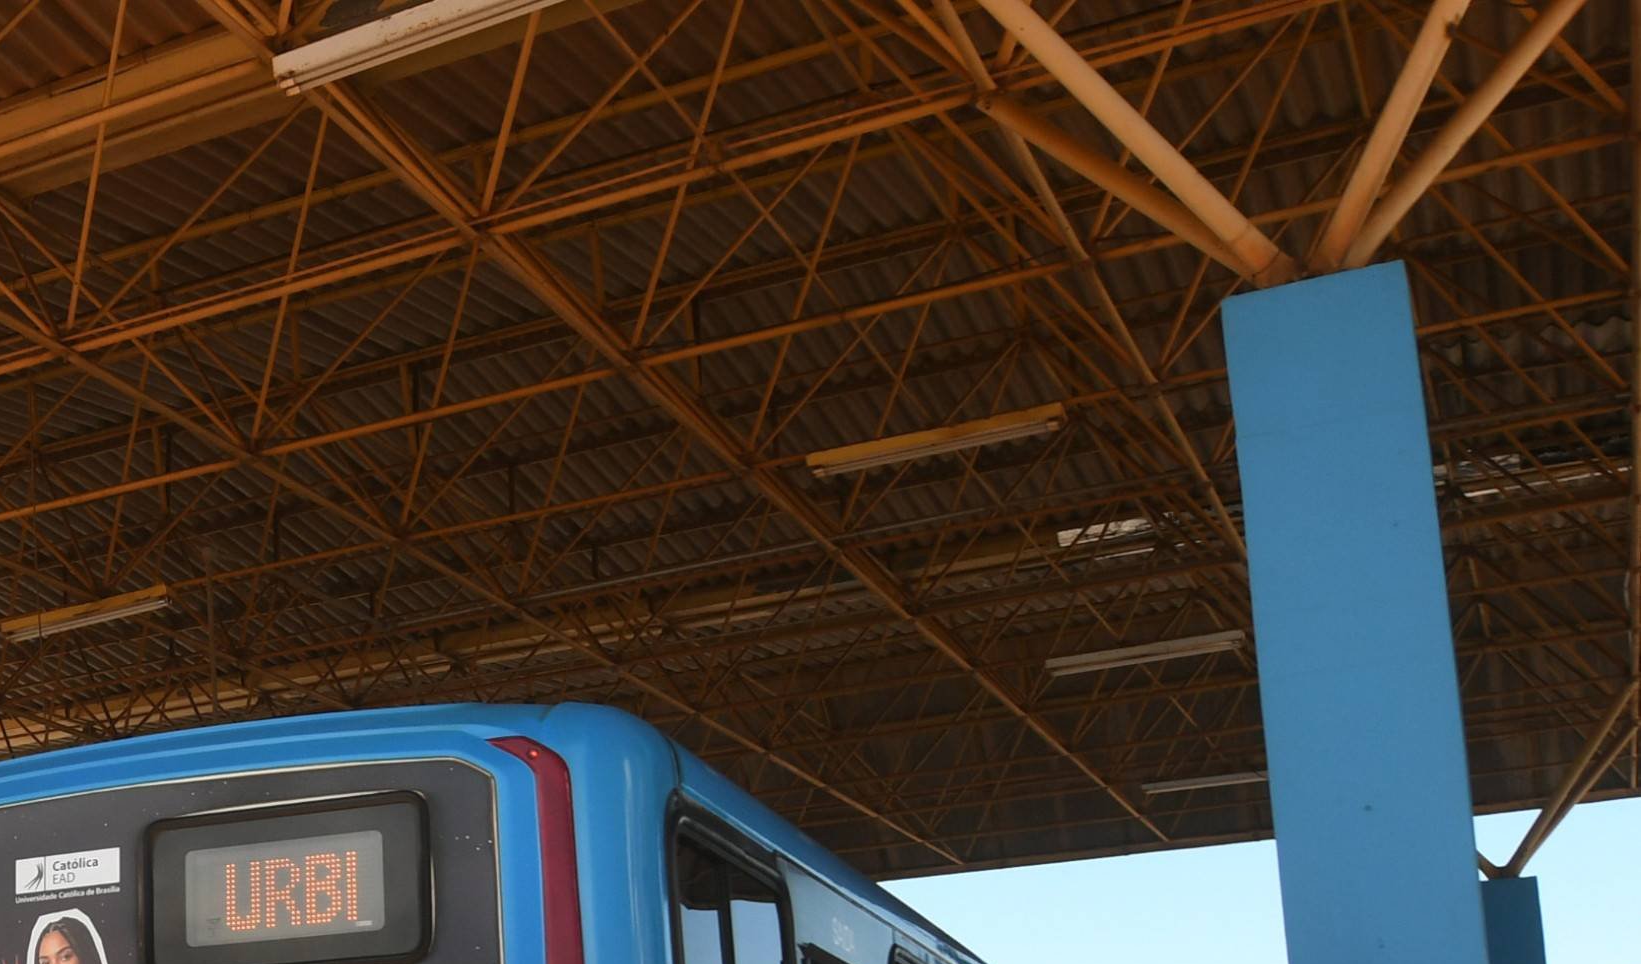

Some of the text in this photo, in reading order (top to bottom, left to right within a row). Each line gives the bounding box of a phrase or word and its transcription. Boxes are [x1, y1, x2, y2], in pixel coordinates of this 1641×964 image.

[52, 859, 99, 872] Católica
[52, 872, 76, 885] EAD
[225, 850, 358, 931] URBI
